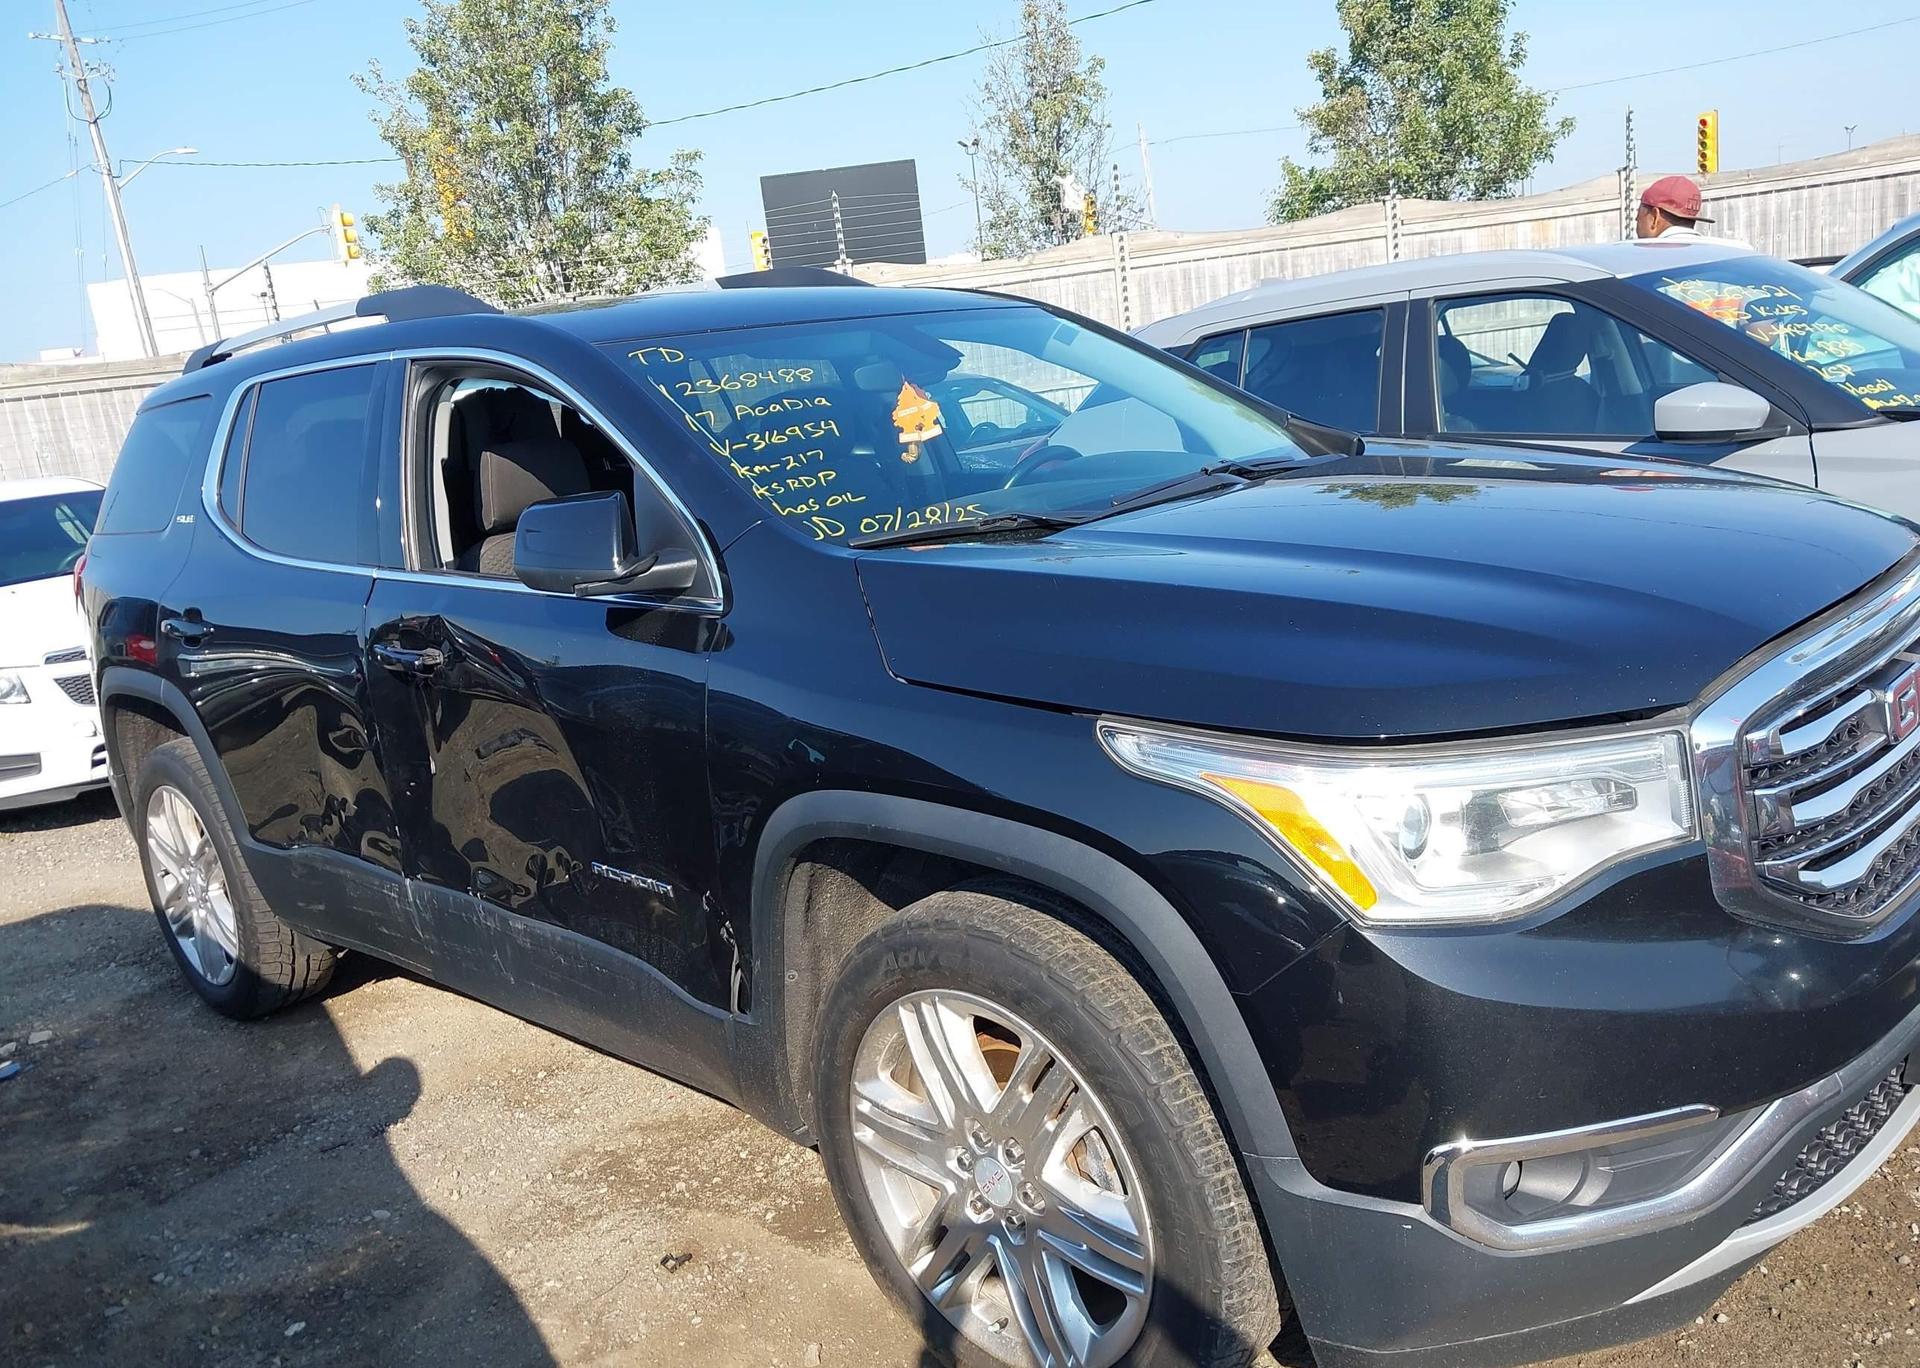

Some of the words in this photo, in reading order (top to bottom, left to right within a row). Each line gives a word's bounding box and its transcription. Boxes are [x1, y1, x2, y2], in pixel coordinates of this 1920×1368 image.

[659, 368, 814, 402] 12368488
[685, 411, 715, 432] 17
[710, 420, 841, 456] V-316954
[859, 502, 989, 533] 07/28/25
[982, 1170, 1004, 1194] GMC
